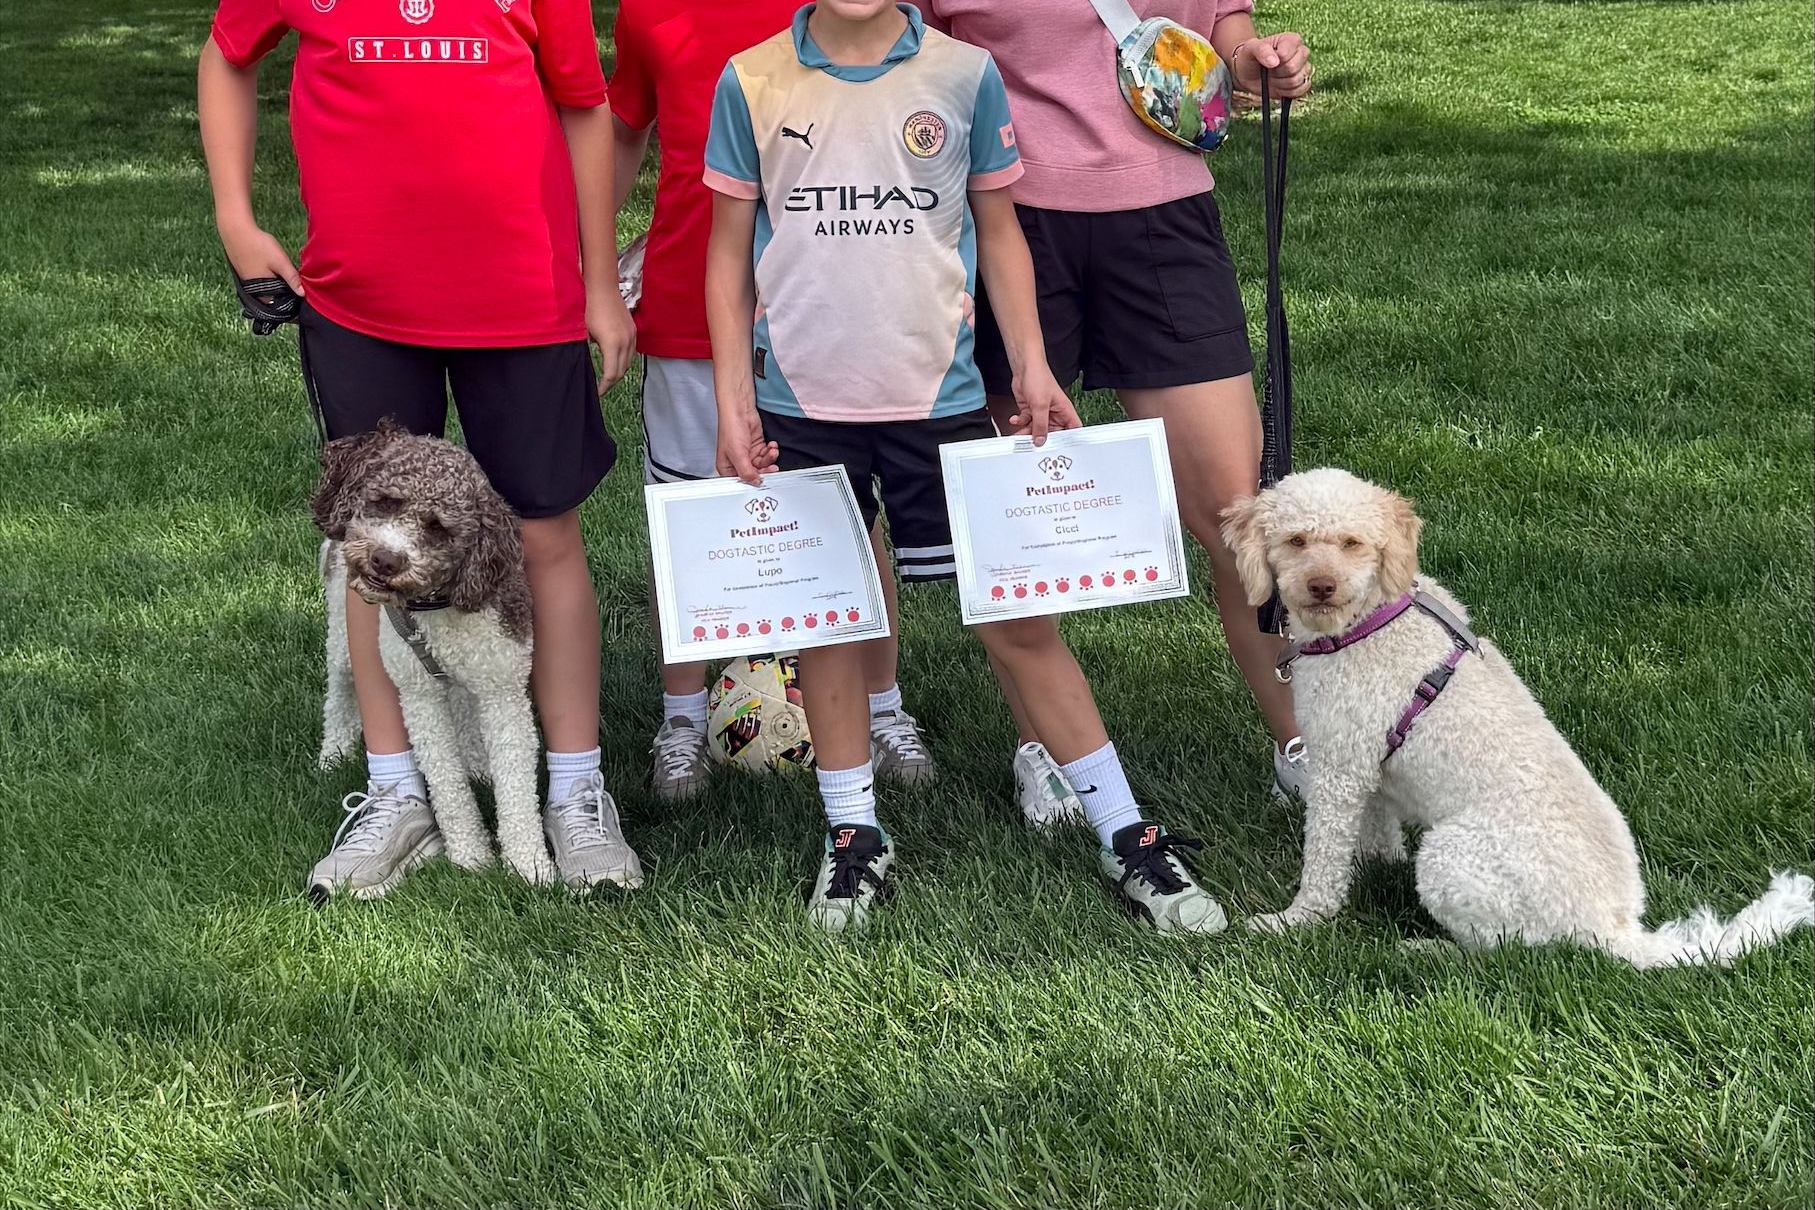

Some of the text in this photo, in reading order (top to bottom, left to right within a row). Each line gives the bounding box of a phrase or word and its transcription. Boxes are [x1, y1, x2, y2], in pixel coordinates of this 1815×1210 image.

[785, 185, 939, 211] ETIHAD
[815, 219, 914, 236] AIRWAYS
[1026, 479, 1095, 497] PetImpact!
[1005, 502, 1071, 519] DOGTASTIC
[1074, 495, 1122, 511] DEGREE
[730, 520, 799, 538] PetImpact!
[708, 537, 823, 560] DOGTASTIC DEGREE
[758, 567, 783, 577] Lupo
